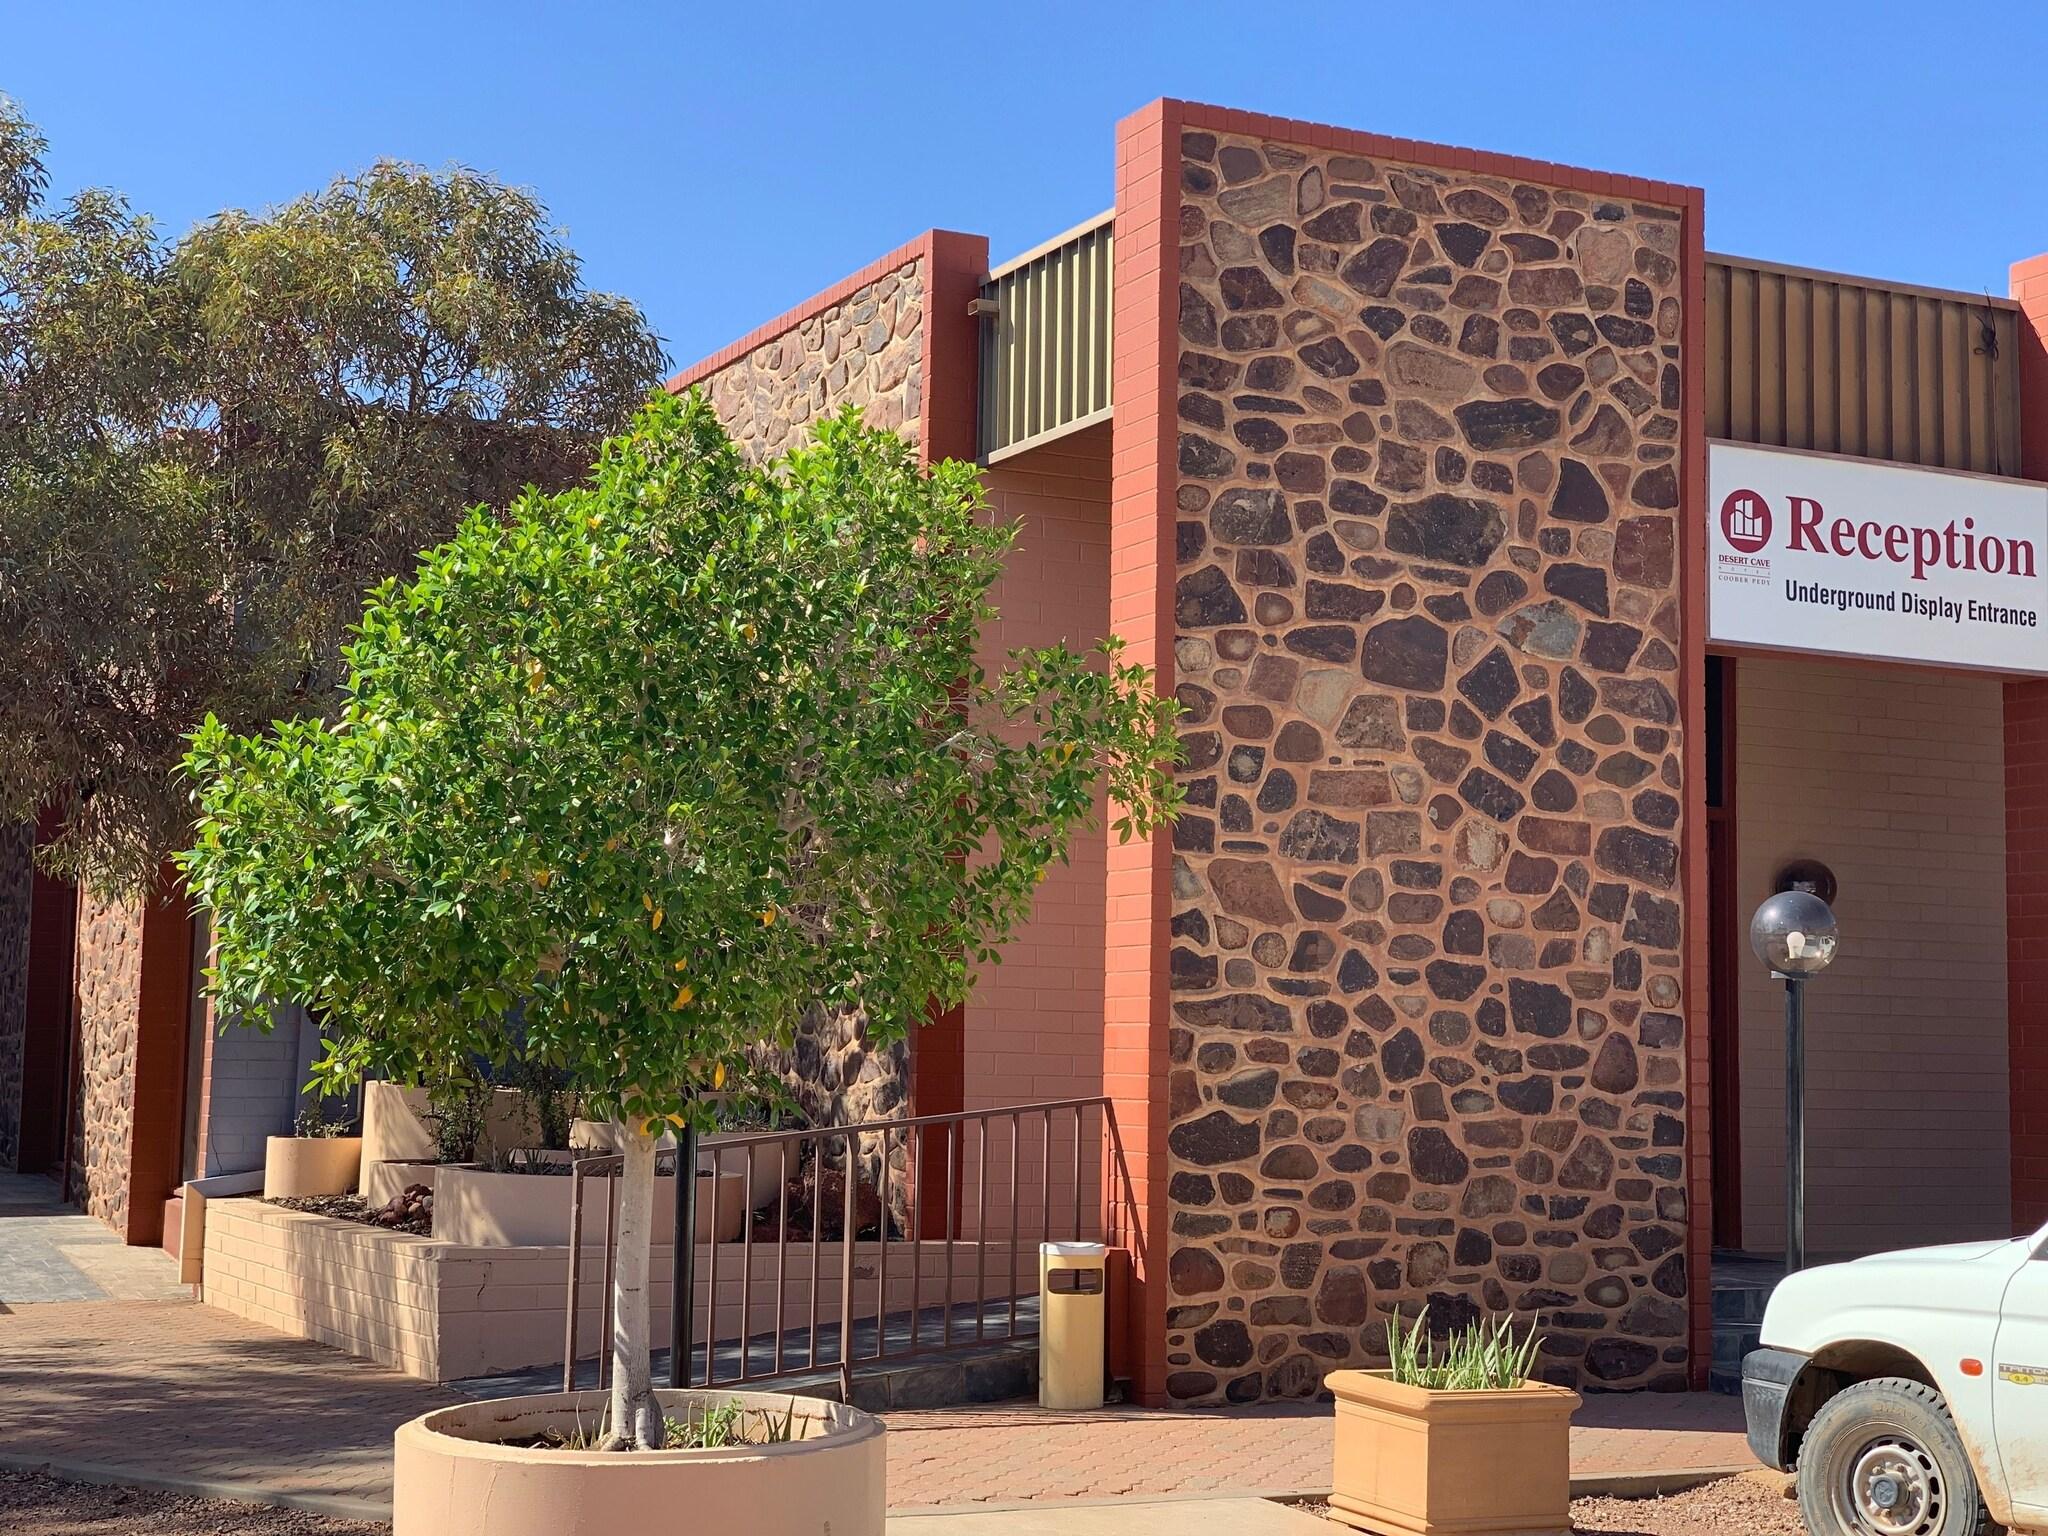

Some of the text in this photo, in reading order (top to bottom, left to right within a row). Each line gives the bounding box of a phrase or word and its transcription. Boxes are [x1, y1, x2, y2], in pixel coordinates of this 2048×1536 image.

[1786, 495, 2037, 580] Reception
[1718, 554, 1770, 567] DESERT CAVE
[1718, 575, 1770, 586] COOBER PEDY
[1785, 579, 2037, 628] Underground Display Entrance
